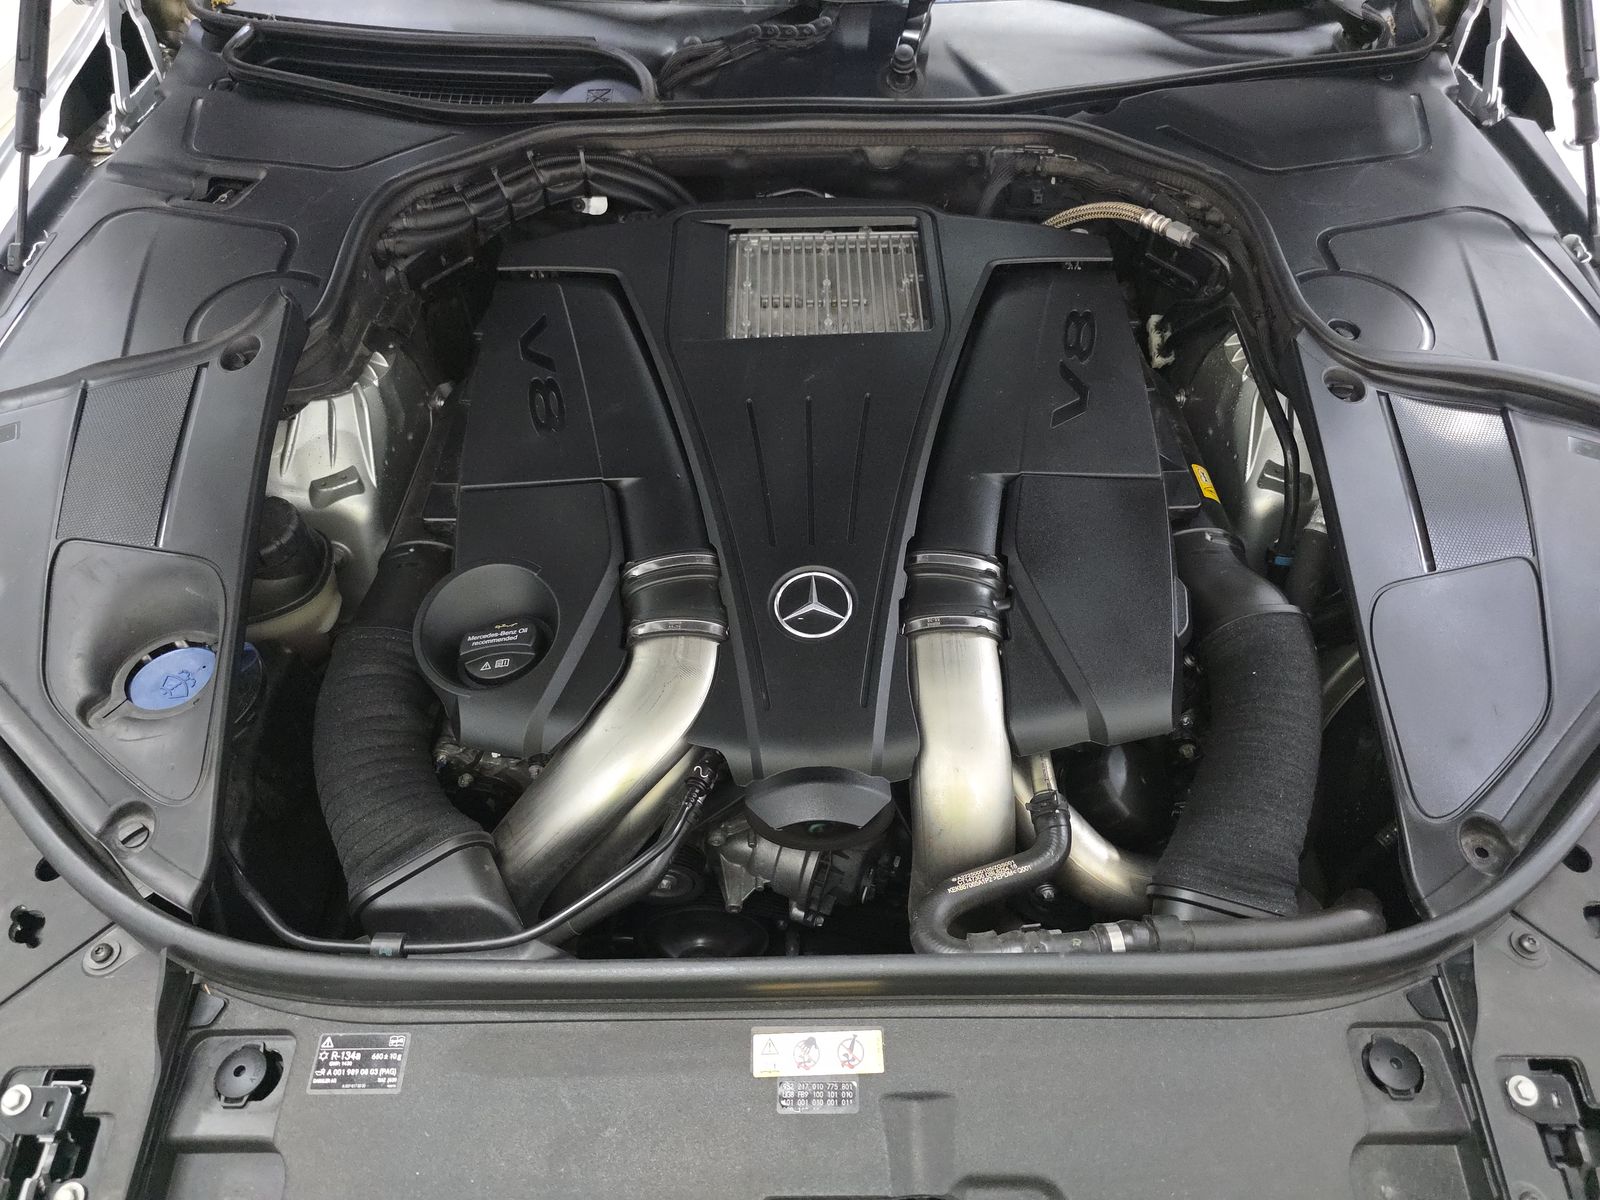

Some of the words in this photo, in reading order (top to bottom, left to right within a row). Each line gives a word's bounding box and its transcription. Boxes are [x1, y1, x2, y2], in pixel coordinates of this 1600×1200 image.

[1049, 308, 1098, 429] V8
[518, 312, 566, 438] V8
[467, 630, 517, 641] Mercedes-Benz
[471, 635, 518, 646] recommended
[331, 1051, 361, 1060] R-134a
[379, 1068, 397, 1077] (PAG)
